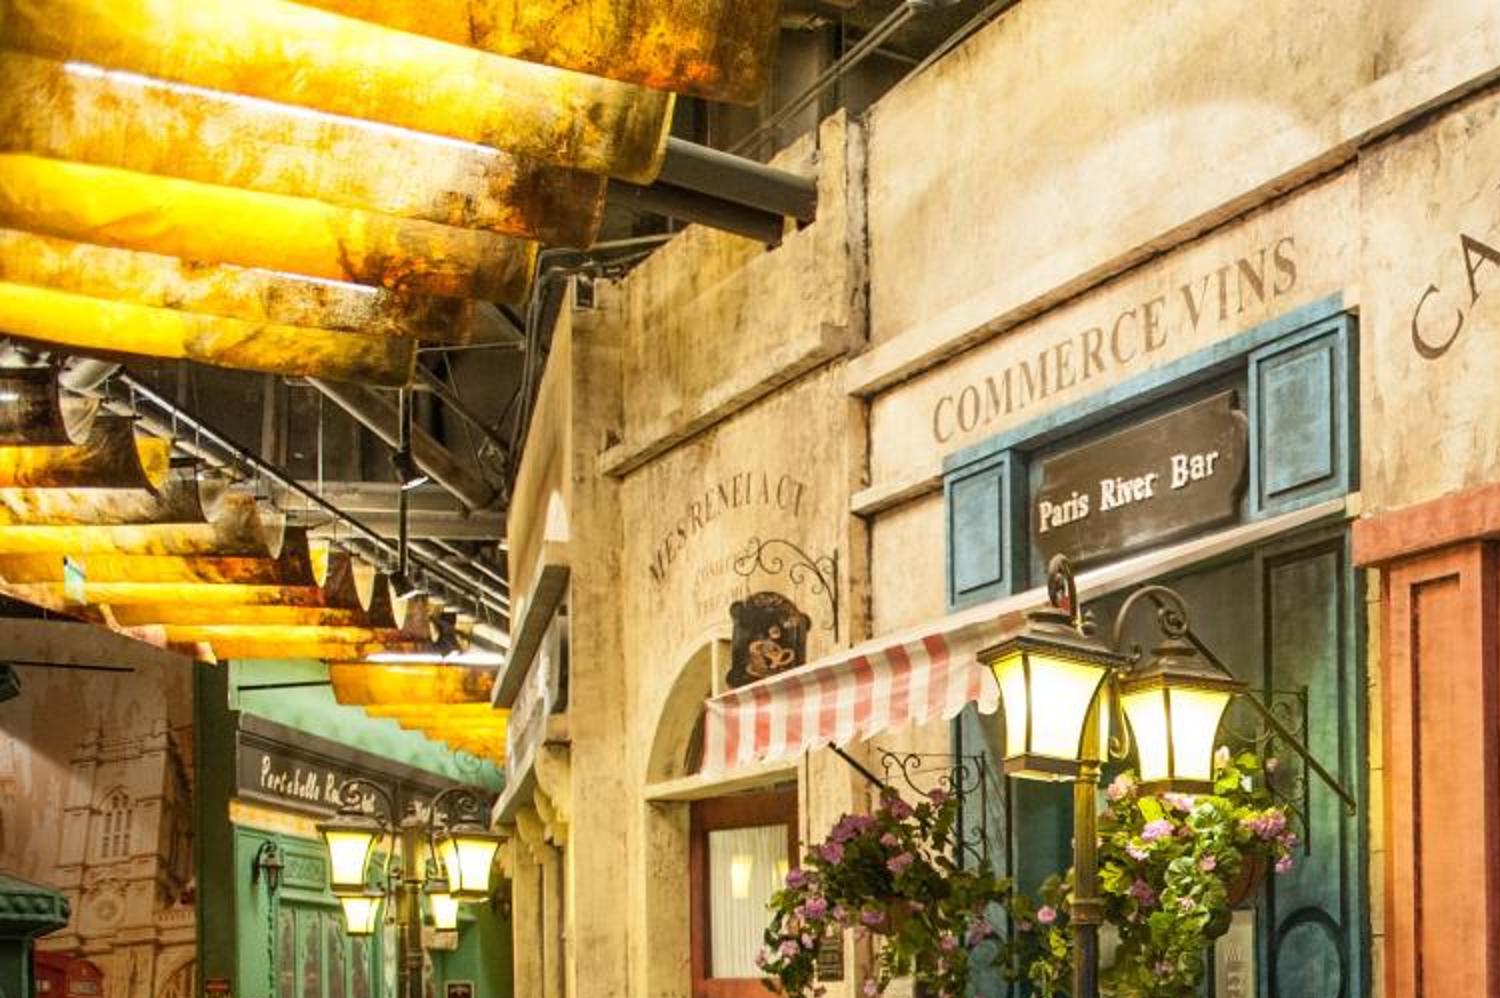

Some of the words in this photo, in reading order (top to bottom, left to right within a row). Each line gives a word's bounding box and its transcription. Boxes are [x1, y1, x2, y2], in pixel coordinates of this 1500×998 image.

[933, 295, 1168, 445] COMMERCE
[1180, 236, 1299, 333] VINS
[1039, 490, 1090, 533] Paris
[1100, 471, 1158, 512] River
[1170, 451, 1220, 490] Bar
